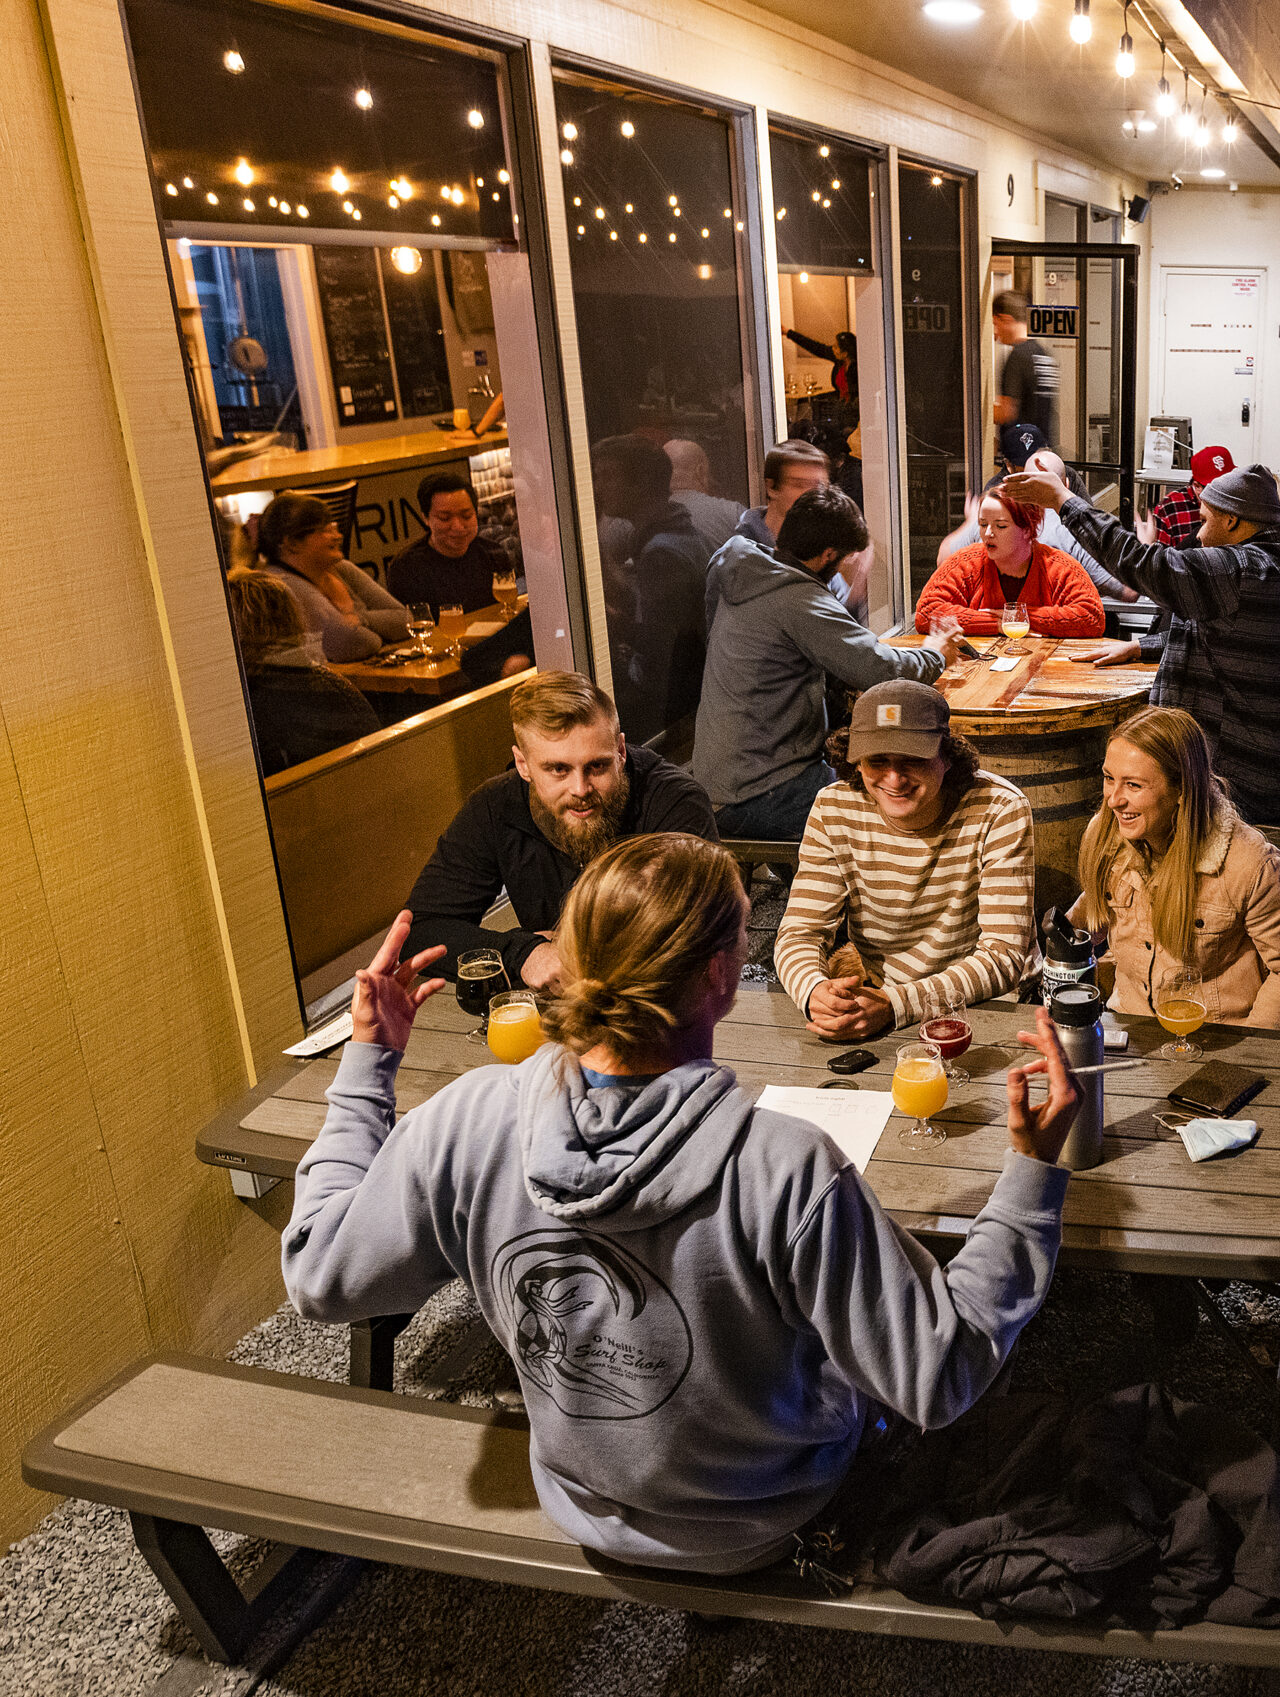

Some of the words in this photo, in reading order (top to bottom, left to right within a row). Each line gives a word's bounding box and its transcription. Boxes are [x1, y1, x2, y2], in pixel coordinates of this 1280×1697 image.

[1007, 173, 1015, 207] 9
[1049, 272, 1057, 285] 9
[1030, 309, 1075, 335] OPEN
[355, 498, 431, 549] RIN
[573, 1344, 617, 1363] Surf
[622, 1353, 668, 1373] Shop
